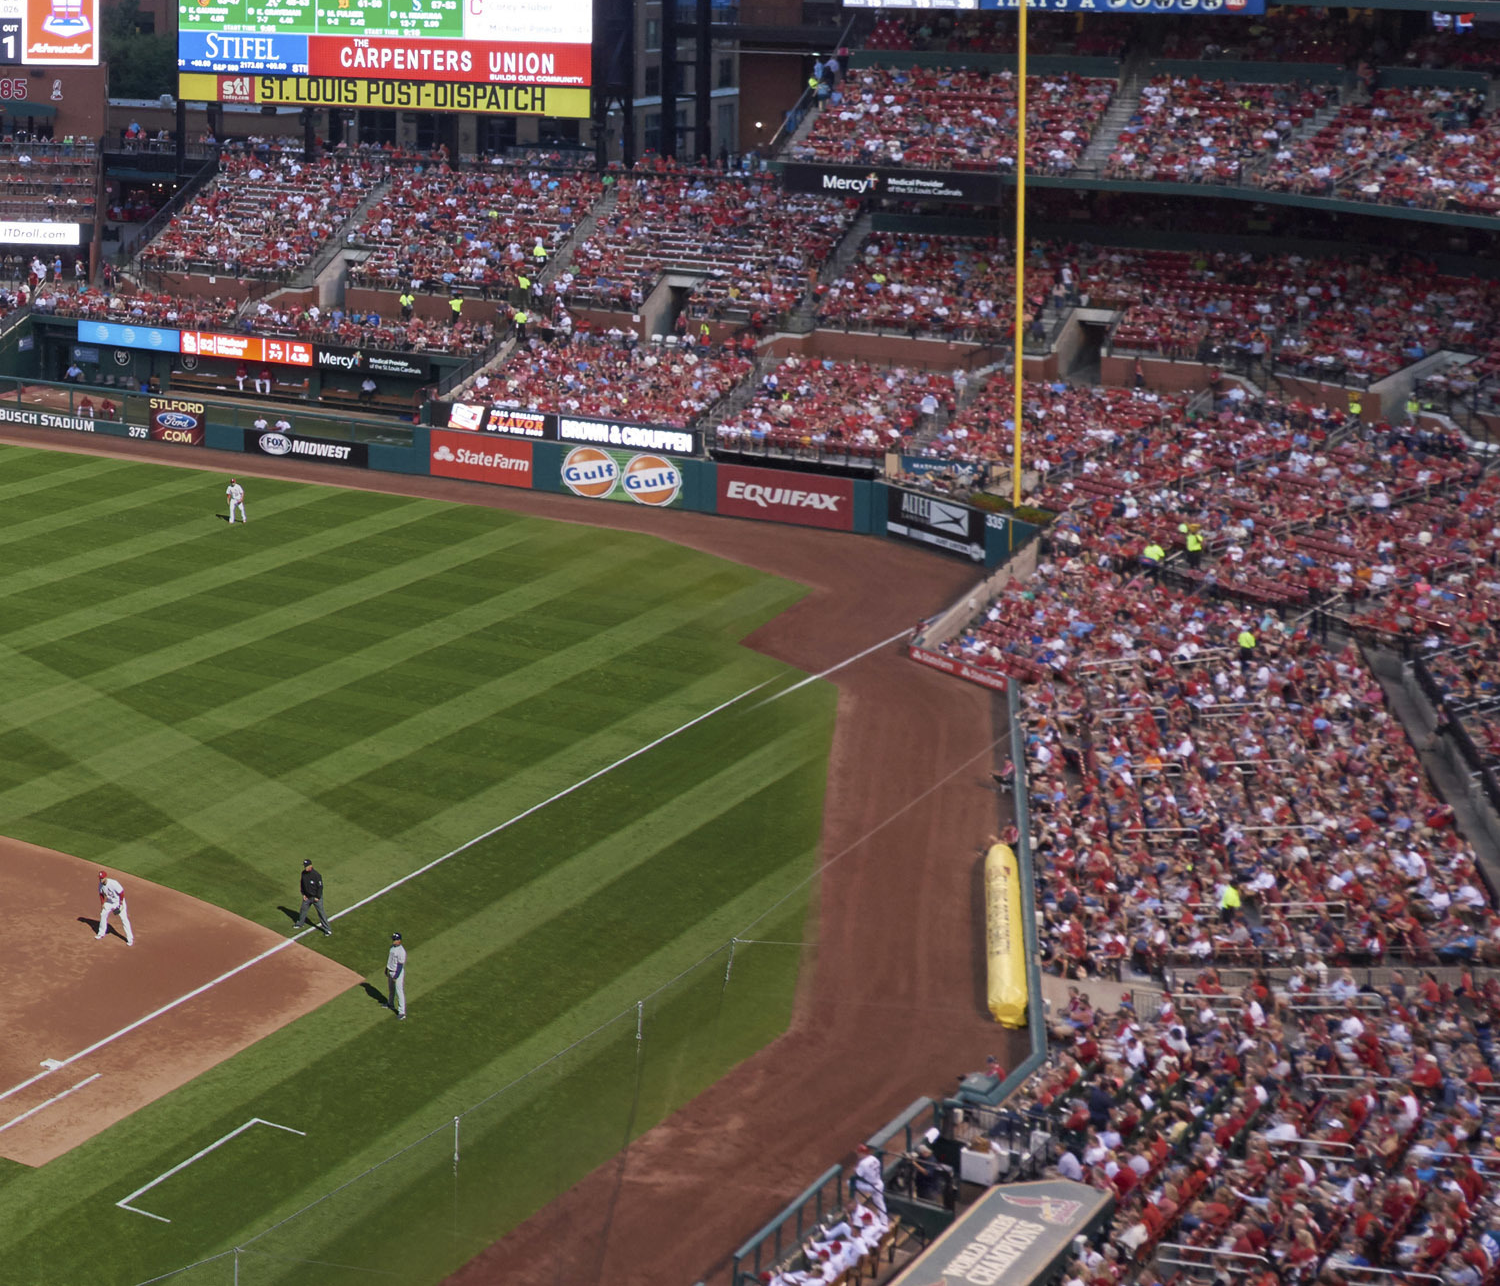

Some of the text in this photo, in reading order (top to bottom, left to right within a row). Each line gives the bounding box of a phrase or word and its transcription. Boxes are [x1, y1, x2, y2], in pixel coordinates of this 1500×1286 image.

[3, 24, 19, 32] OUT
[2, 35, 14, 59] 1
[205, 33, 279, 60] STIFEL
[354, 39, 369, 47] THE
[340, 46, 554, 74] CARPENTERS UNION
[0, 79, 28, 100] 85
[261, 77, 544, 111] ST. LOUIS POST-DISPATCH
[823, 175, 868, 193] Mercy
[319, 351, 354, 368] Mercy
[150, 398, 204, 414] STLFORD
[39, 411, 95, 432] STADIUM
[163, 414, 190, 428] Ford
[128, 426, 148, 439] 375'
[162, 430, 192, 444] .COM
[561, 419, 693, 453] BROWN & CROUPPEN
[266, 437, 351, 460] FOX MIDWEST
[565, 464, 615, 482] Gulf
[625, 470, 676, 490] Gulf
[727, 481, 841, 511] EQUIFAX
[942, 1242, 989, 1277] WORLD
[965, 1219, 1046, 1286] CHAMPIONS
